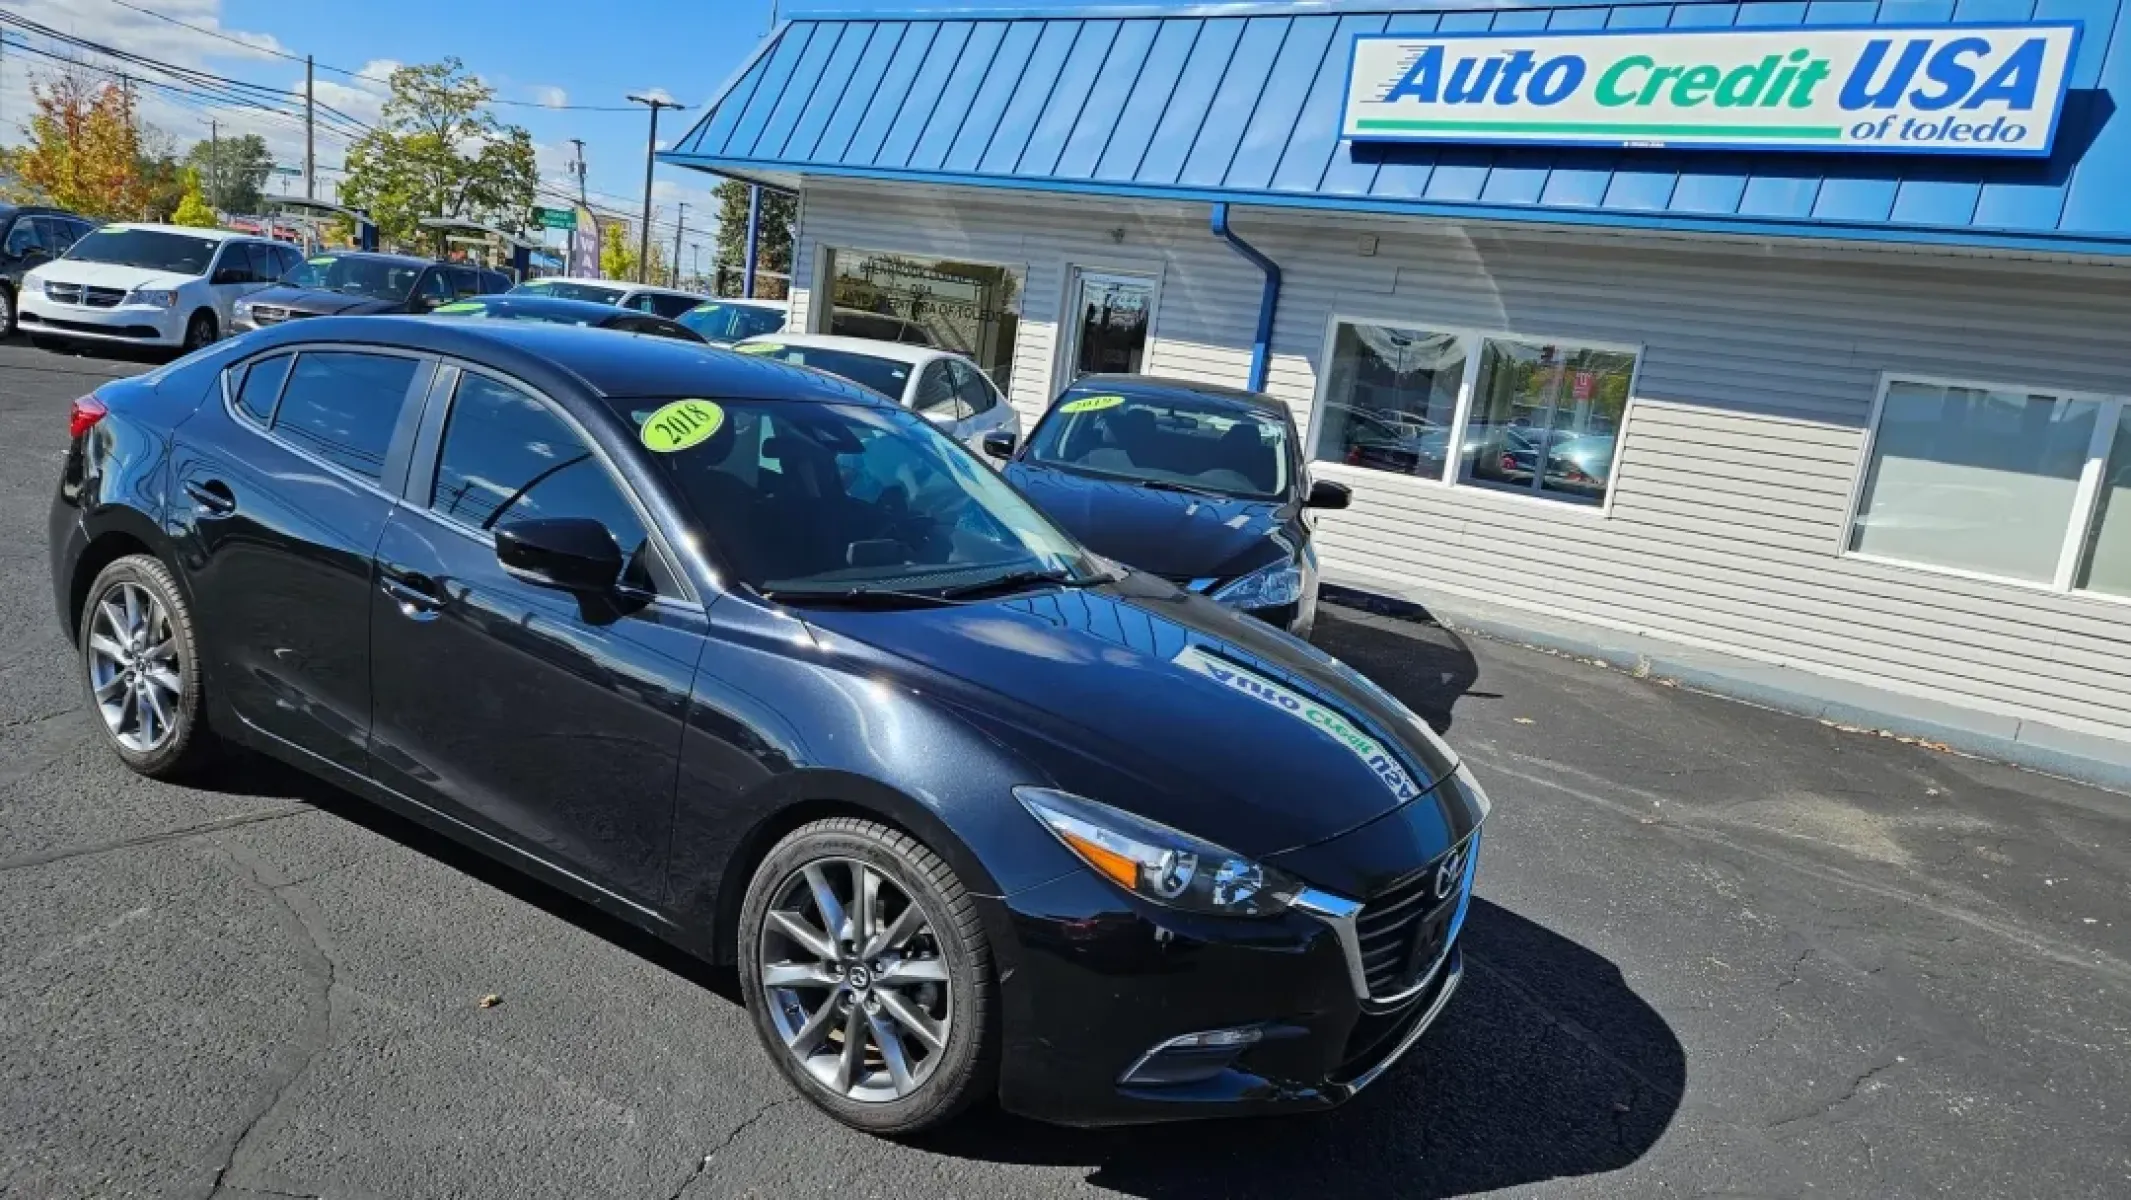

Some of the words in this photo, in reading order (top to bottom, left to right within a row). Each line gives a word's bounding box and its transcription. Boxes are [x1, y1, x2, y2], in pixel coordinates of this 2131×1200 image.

[1380, 44, 1587, 106] Auto
[1593, 48, 1831, 109] Credit
[1838, 36, 2048, 111] USA
[1850, 114, 1898, 140] of
[1899, 115, 2028, 143] toledo
[654, 402, 711, 445] 2018
